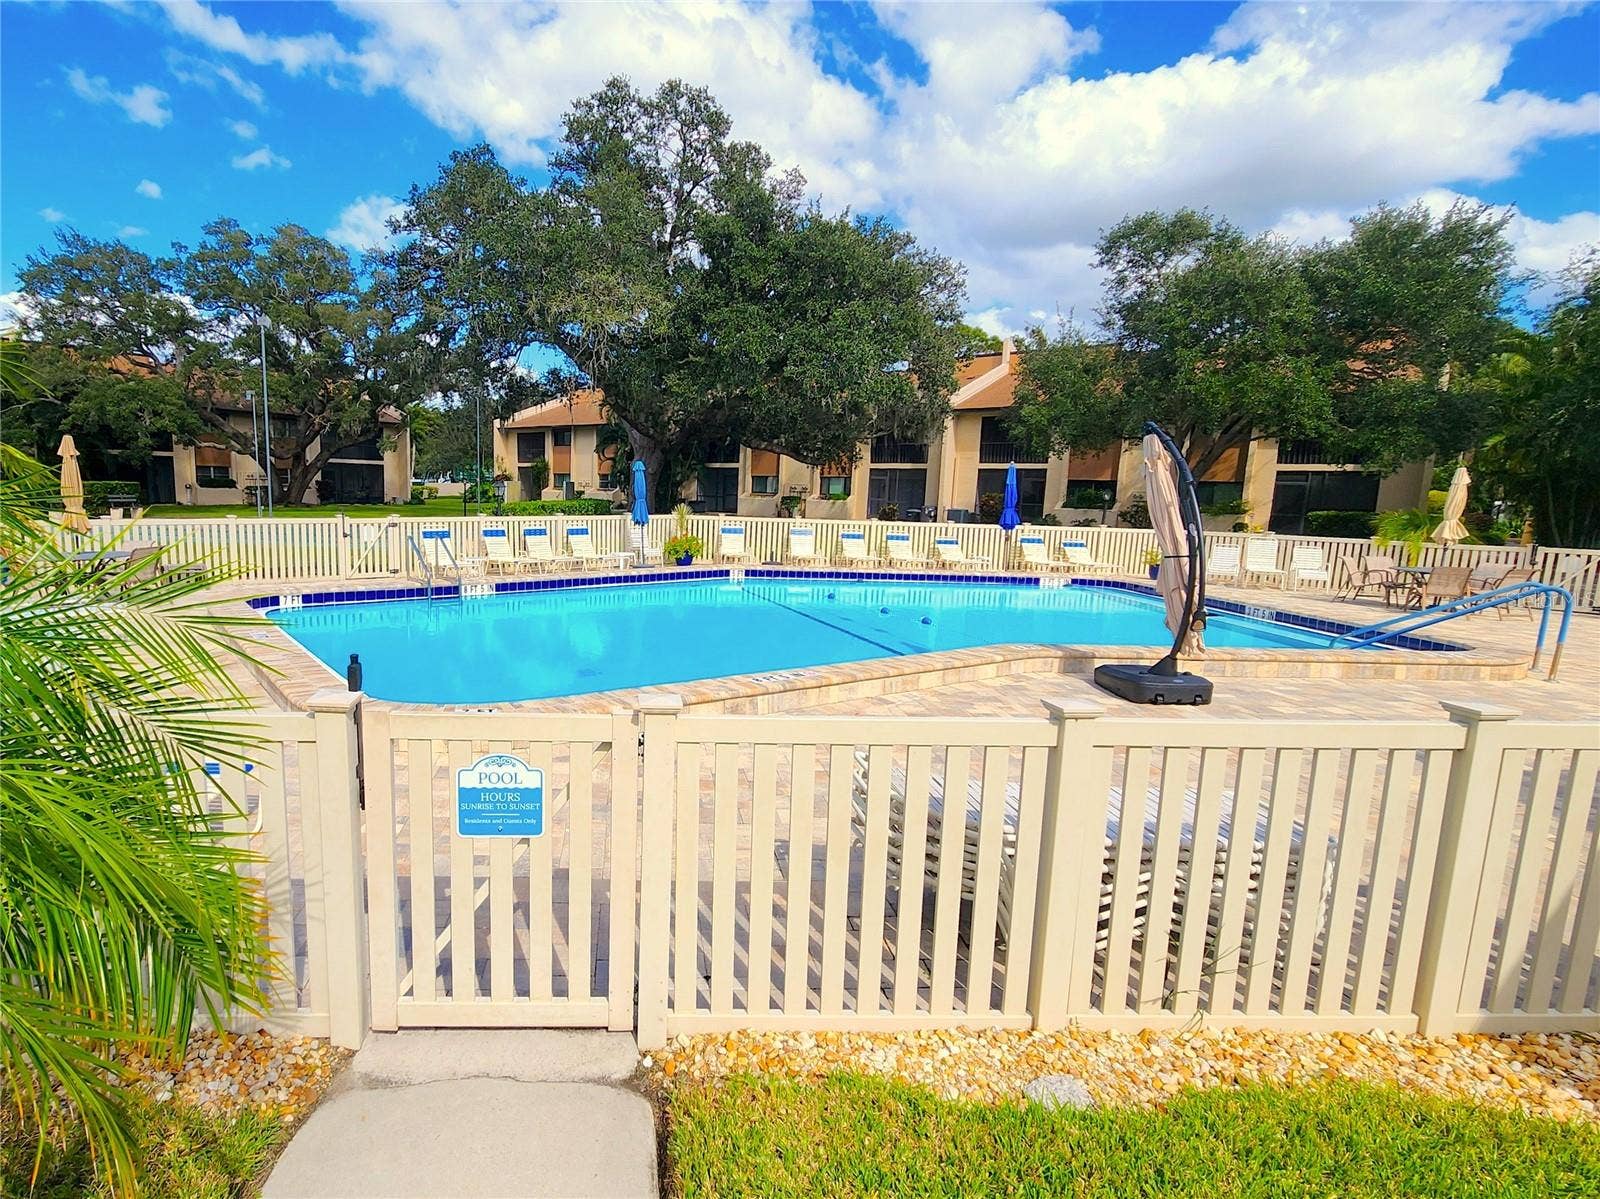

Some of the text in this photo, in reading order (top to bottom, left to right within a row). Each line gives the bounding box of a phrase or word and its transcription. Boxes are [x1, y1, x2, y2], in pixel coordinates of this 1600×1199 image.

[470, 584, 478, 593] FT
[283, 594, 300, 605] 7 FT
[1253, 607, 1260, 617] FT
[478, 771, 523, 785] POOL
[480, 792, 521, 802] HOURS
